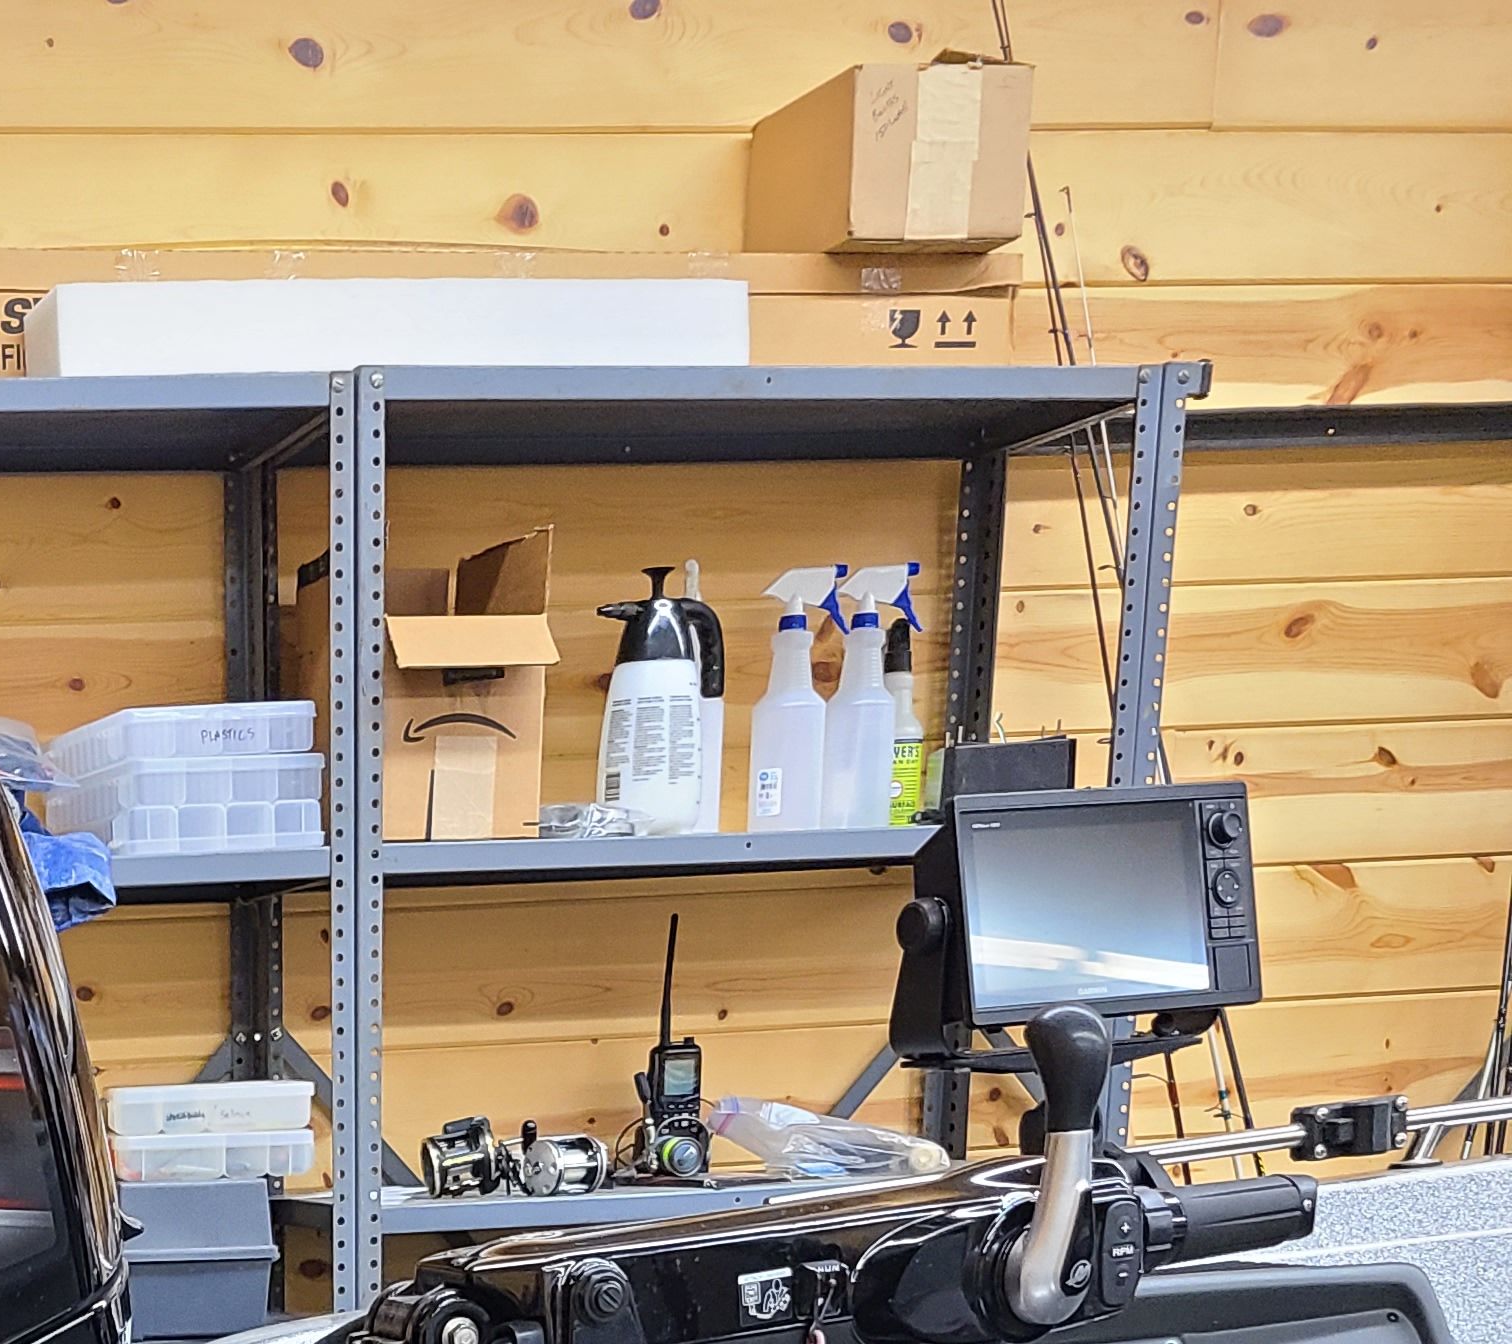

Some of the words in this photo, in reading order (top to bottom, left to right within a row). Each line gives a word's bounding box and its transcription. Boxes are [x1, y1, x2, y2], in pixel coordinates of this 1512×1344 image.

[0, 297, 43, 335] S
[1, 343, 26, 371] FI
[200, 727, 255, 744] PLASTICS
[1112, 1244, 1135, 1257] RPM
